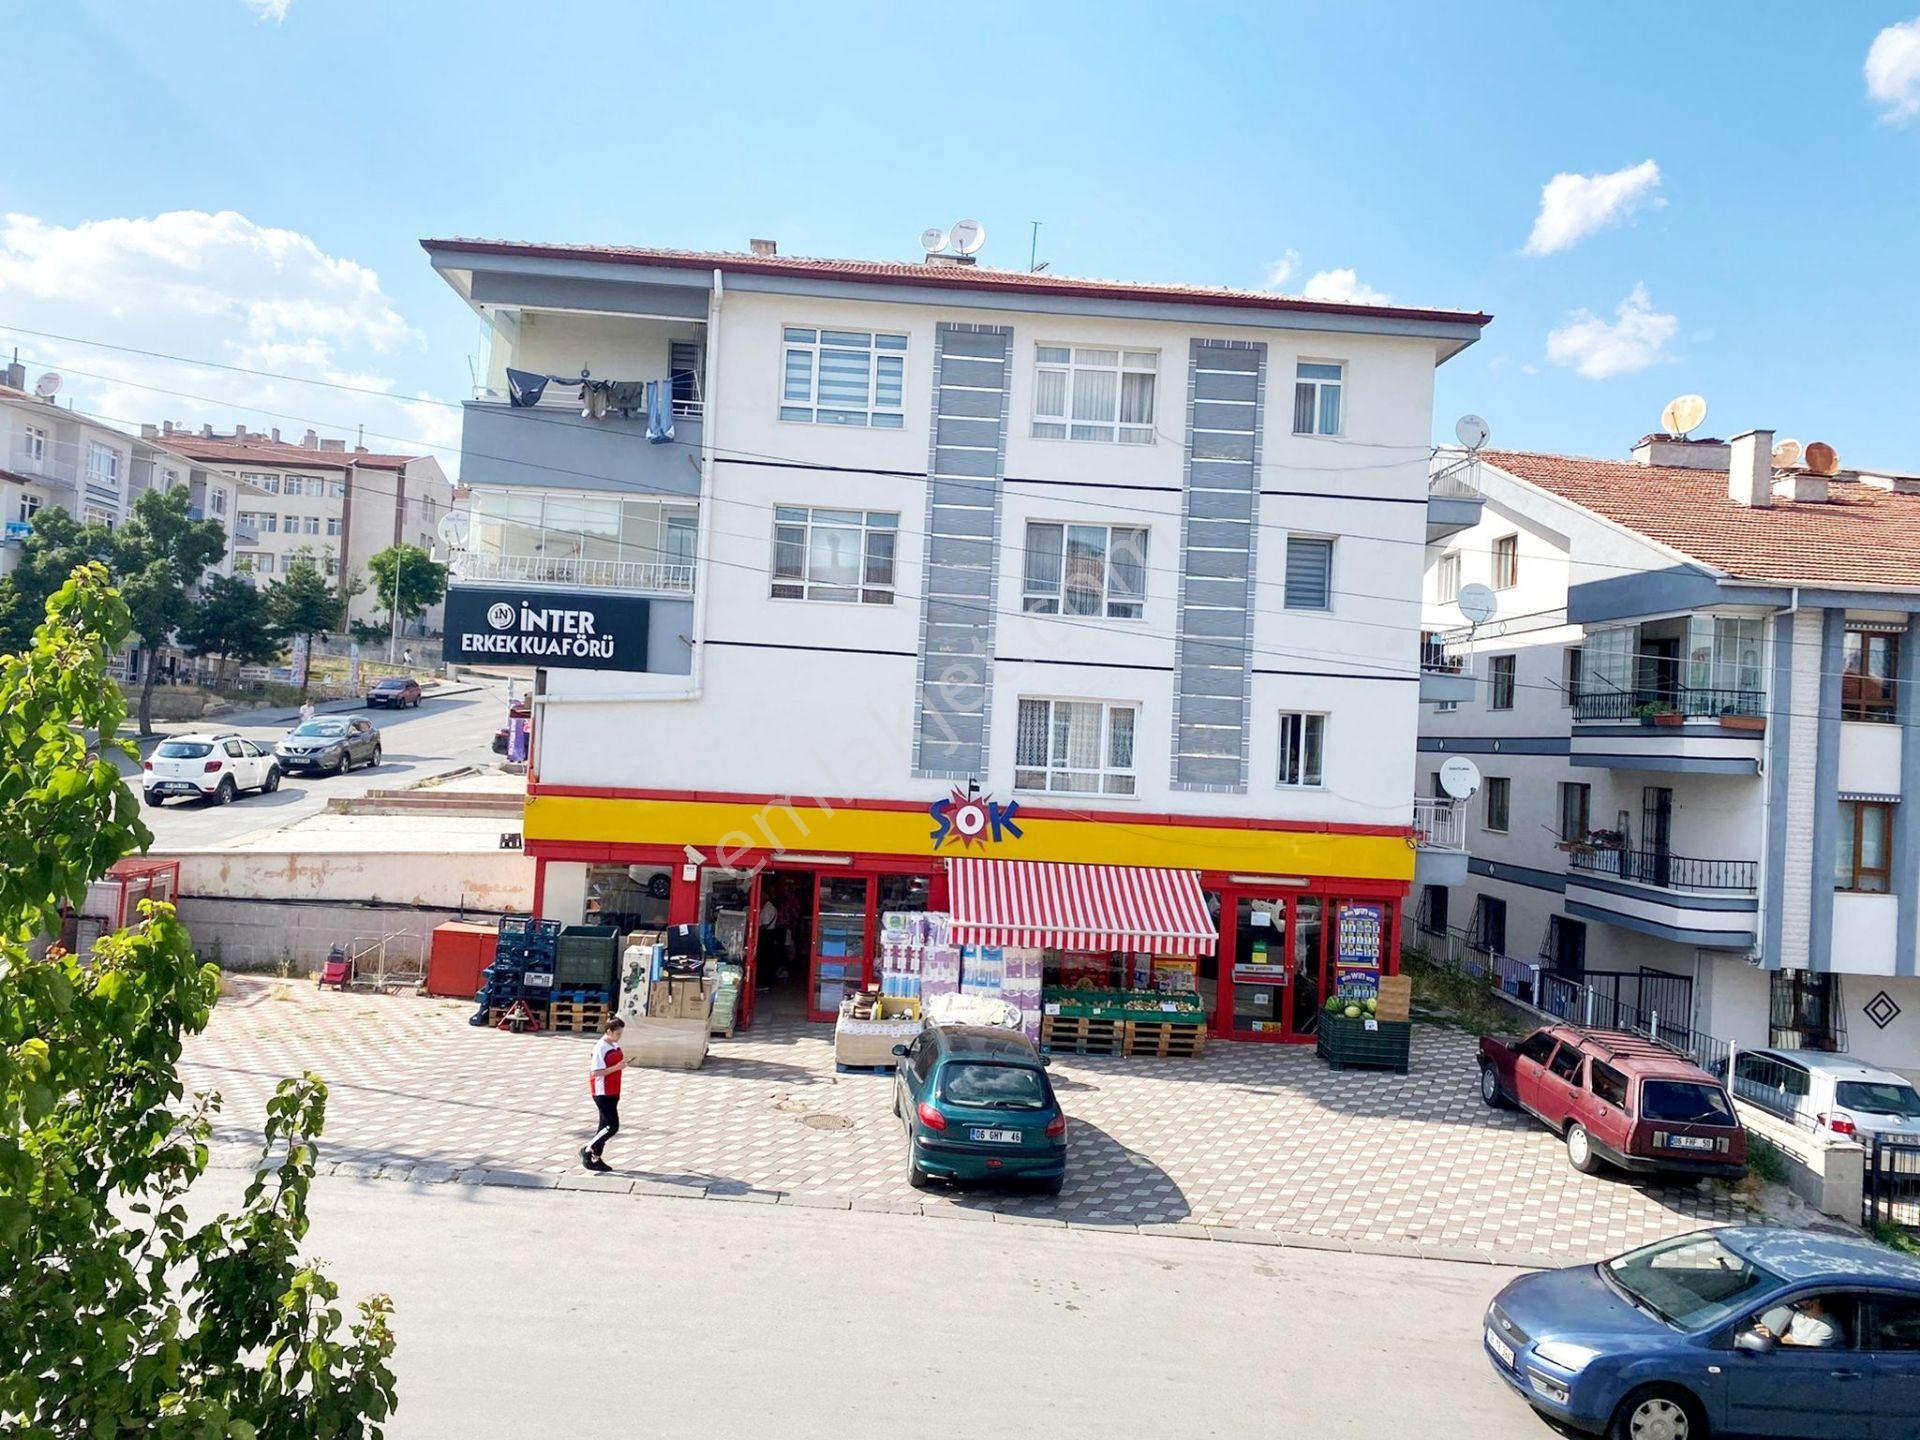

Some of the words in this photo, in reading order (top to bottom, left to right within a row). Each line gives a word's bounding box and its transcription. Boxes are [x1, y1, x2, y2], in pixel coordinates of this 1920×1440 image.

[520, 600, 596, 634] İNTER
[461, 633, 519, 653] ERKEK
[521, 634, 615, 658] KUAFÖRÜ
[928, 798, 1024, 851] ŞOK
[976, 1130, 985, 1139] 06
[1011, 1132, 1020, 1141] 46
